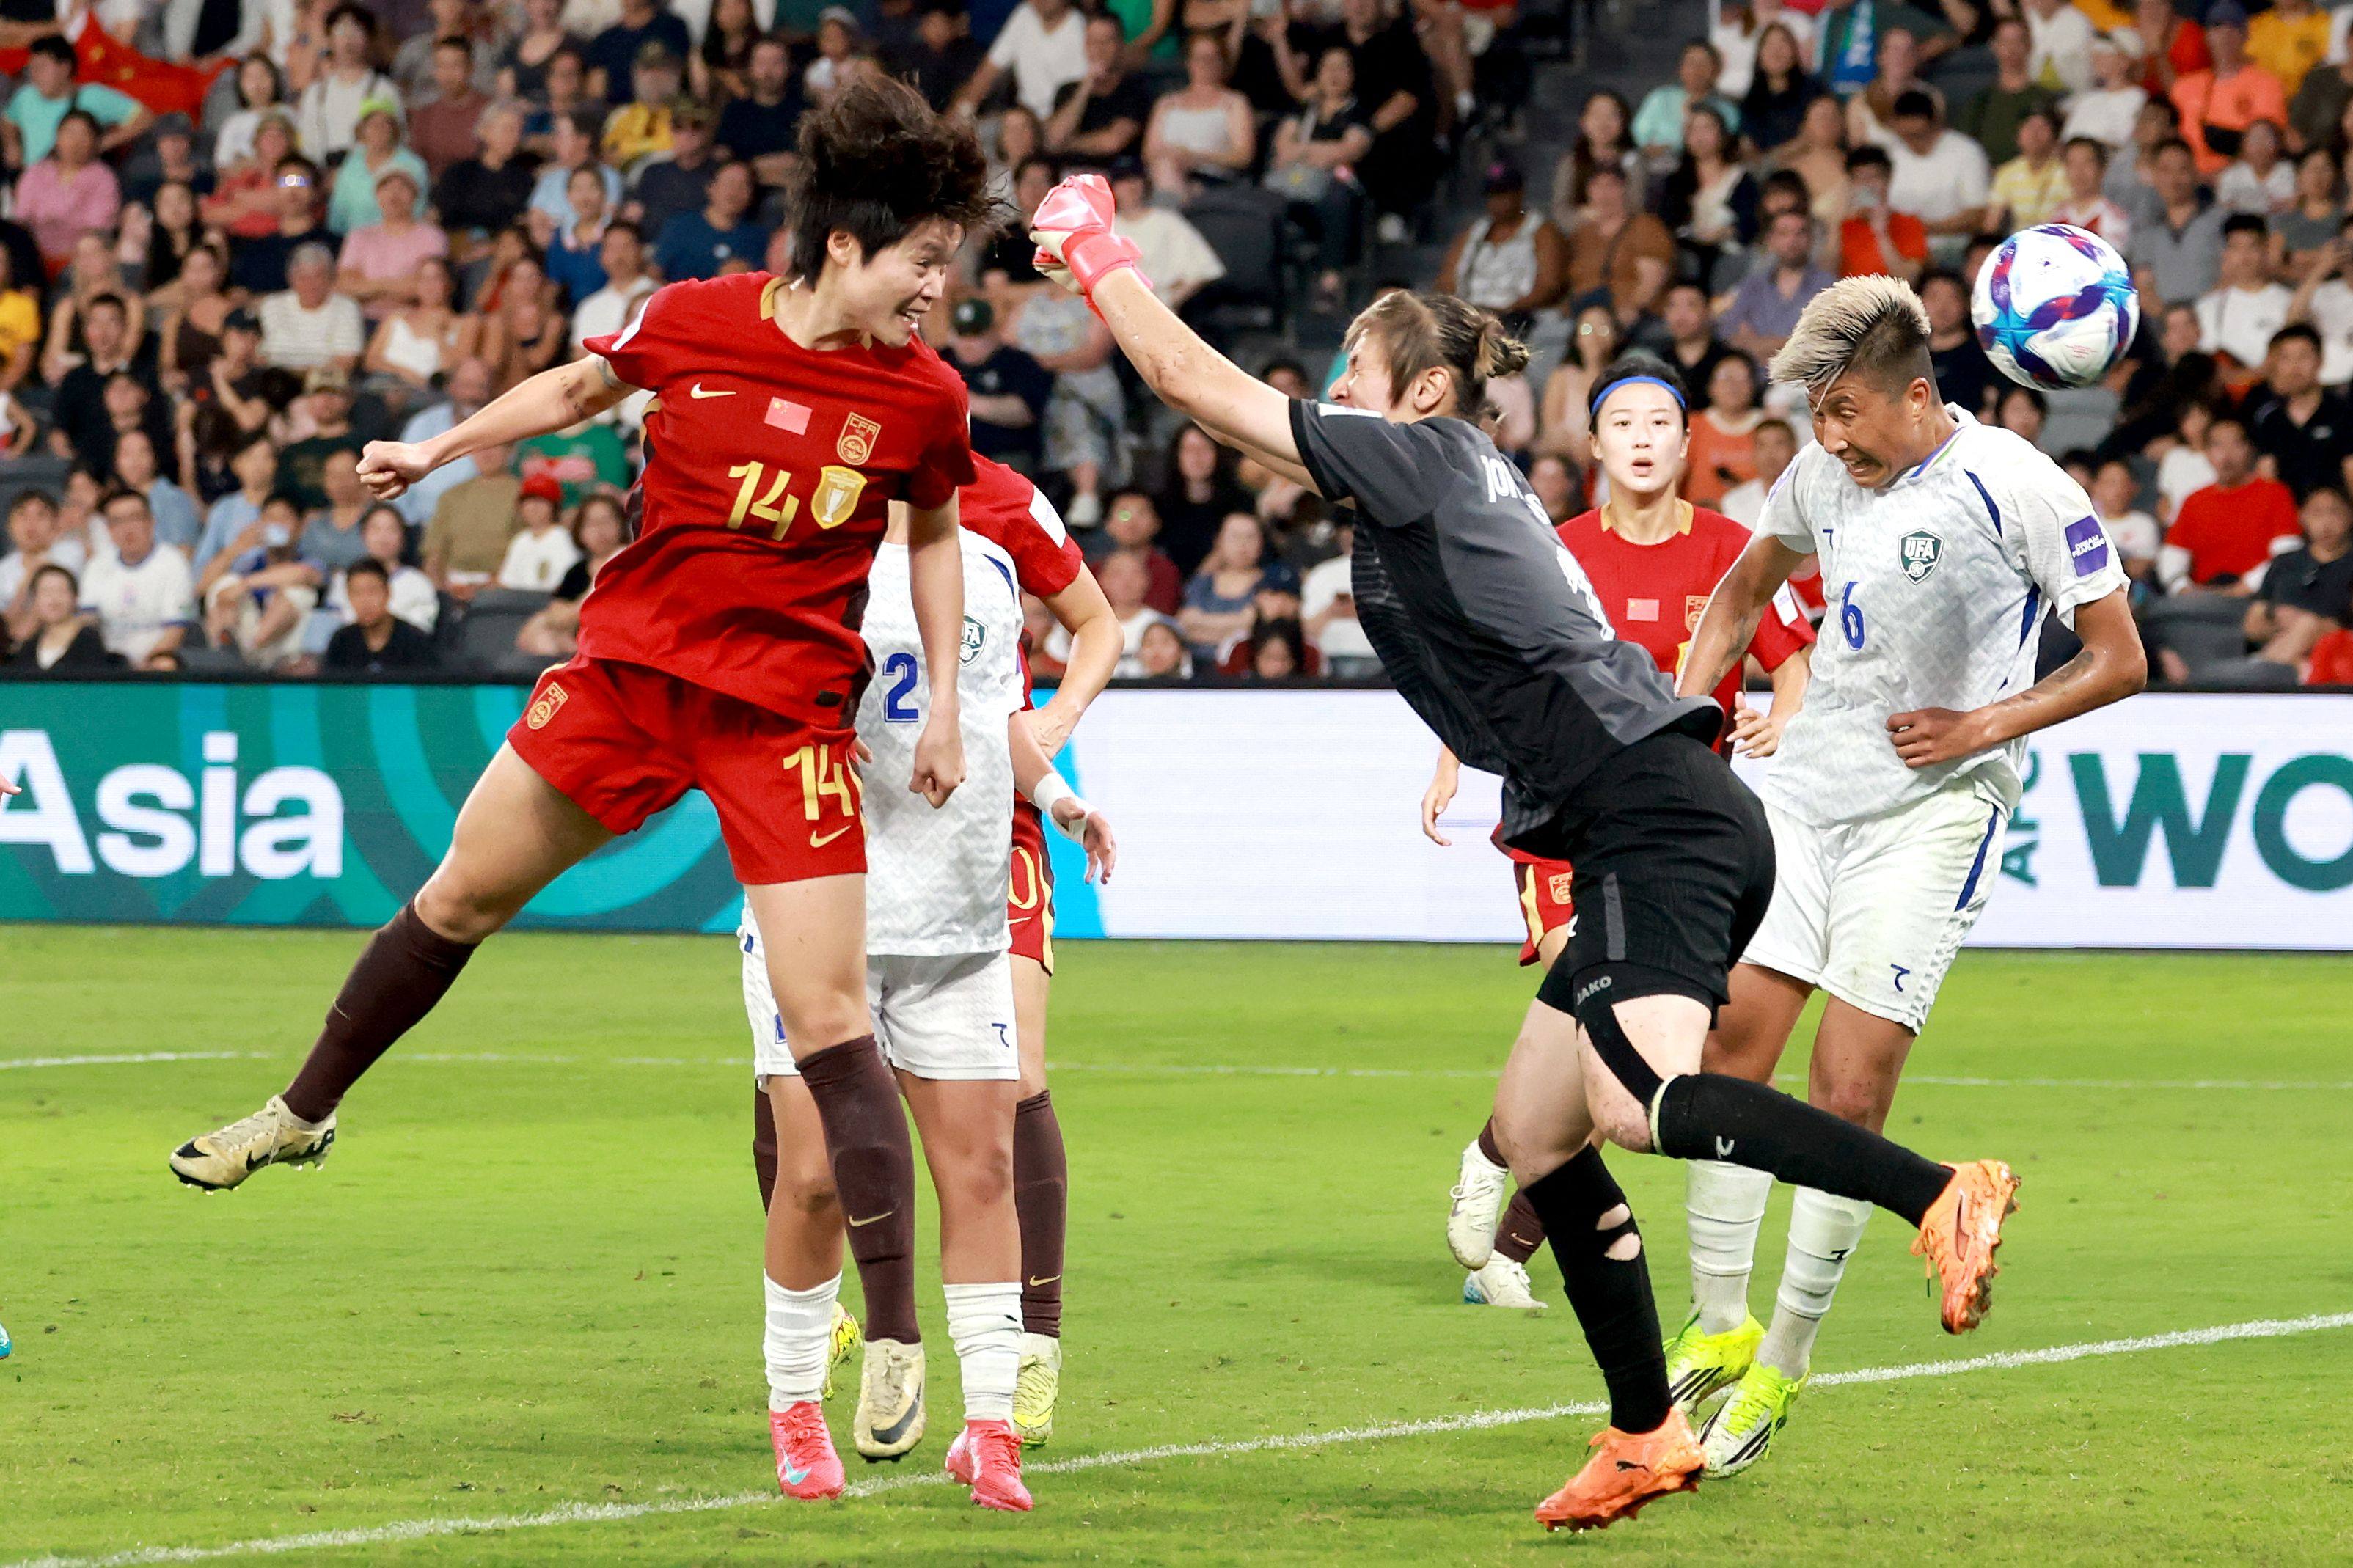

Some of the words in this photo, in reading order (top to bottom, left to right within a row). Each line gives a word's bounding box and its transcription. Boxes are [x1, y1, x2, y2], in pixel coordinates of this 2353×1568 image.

[727, 461, 799, 541] 14
[1904, 538, 1935, 560] UFA
[962, 623, 981, 645] FA
[1840, 581, 1865, 651] 6
[882, 653, 919, 722] 2
[0, 729, 344, 879] Asia
[783, 744, 854, 820] 14
[2068, 752, 2353, 892] WO
[1578, 975, 1612, 1005] JAKO
